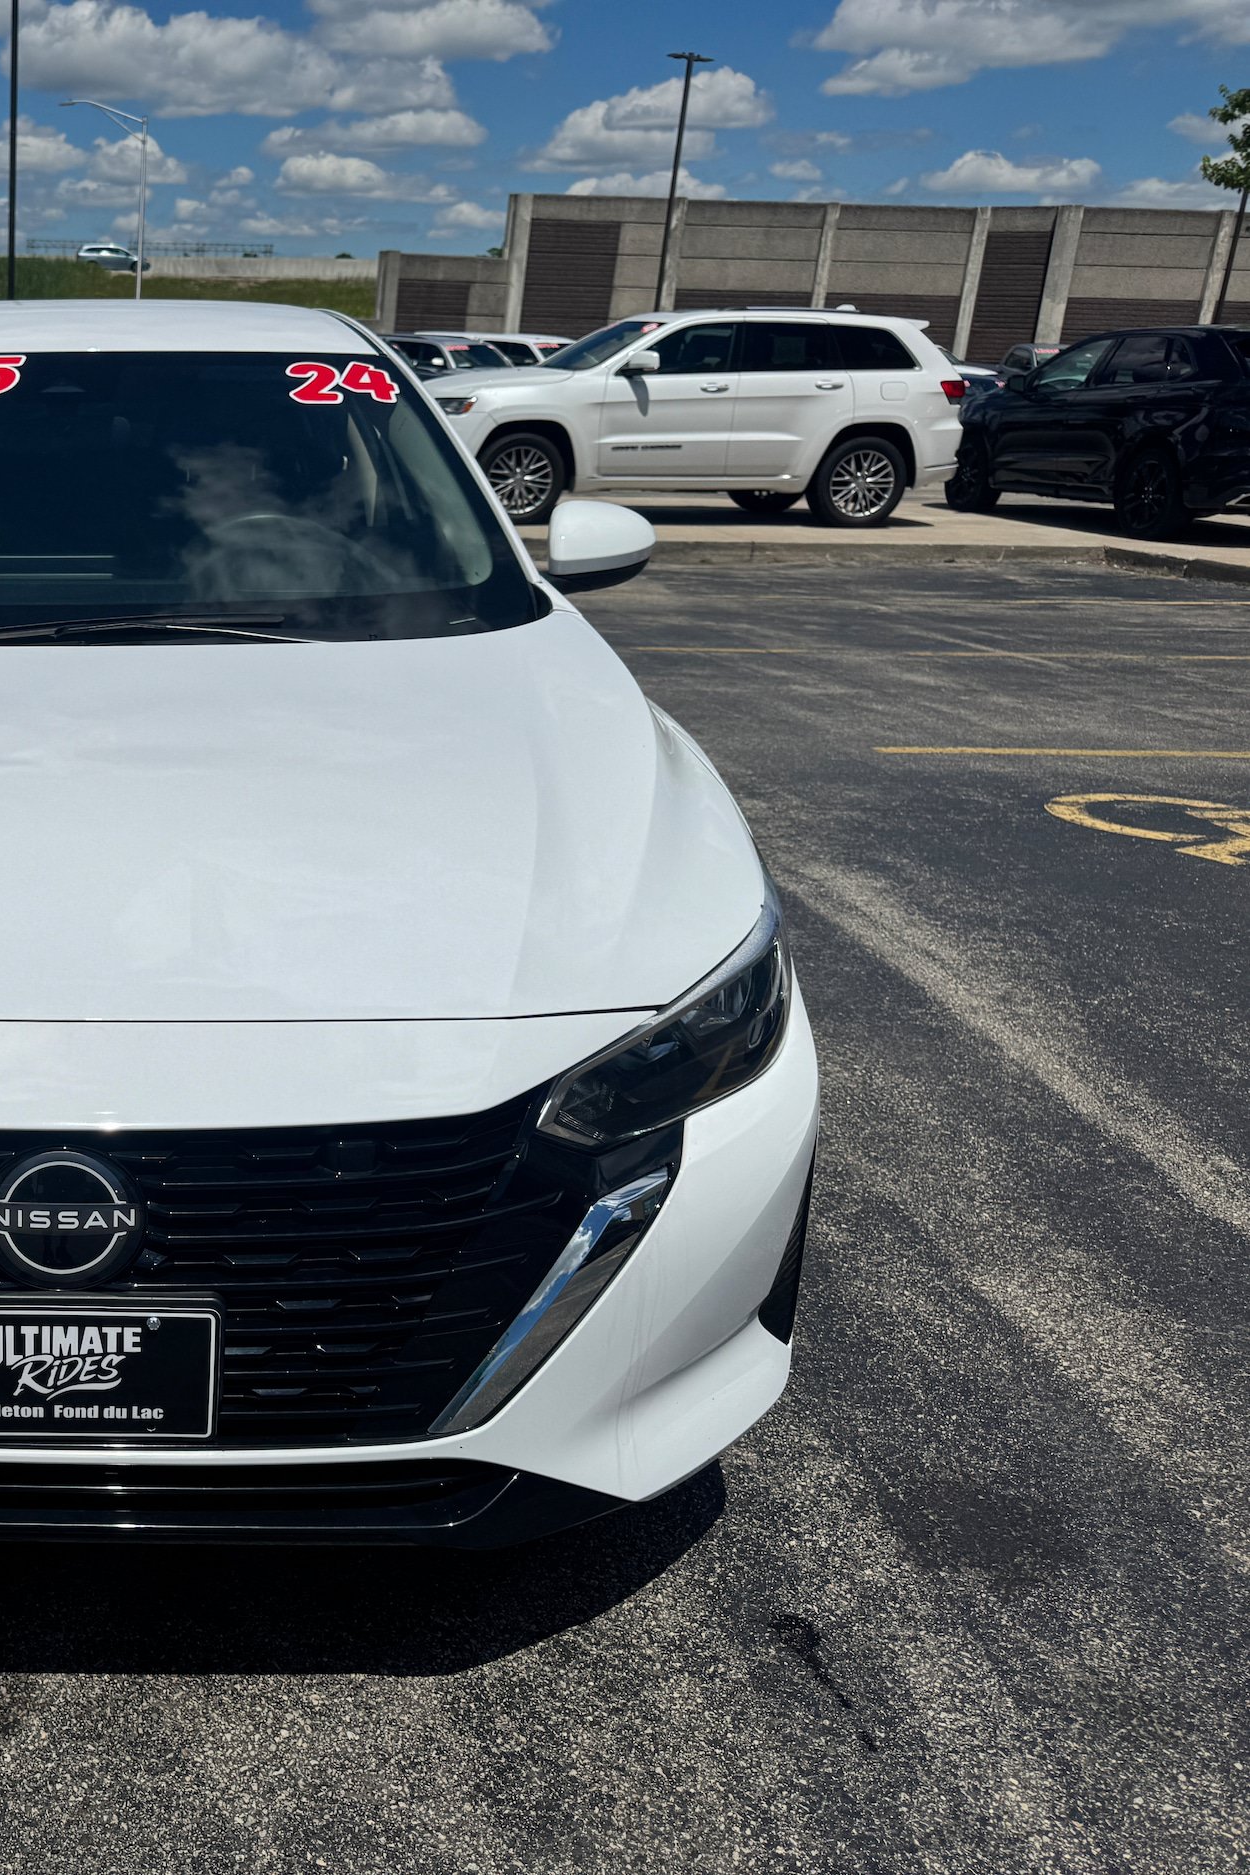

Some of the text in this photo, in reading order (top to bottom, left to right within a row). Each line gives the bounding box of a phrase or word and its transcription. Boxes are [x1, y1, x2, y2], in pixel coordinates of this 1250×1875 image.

[285, 360, 400, 404] 24
[53, 1404, 99, 1420] Fond
[103, 1404, 128, 1420] du
[131, 1405, 165, 1421] Lac
